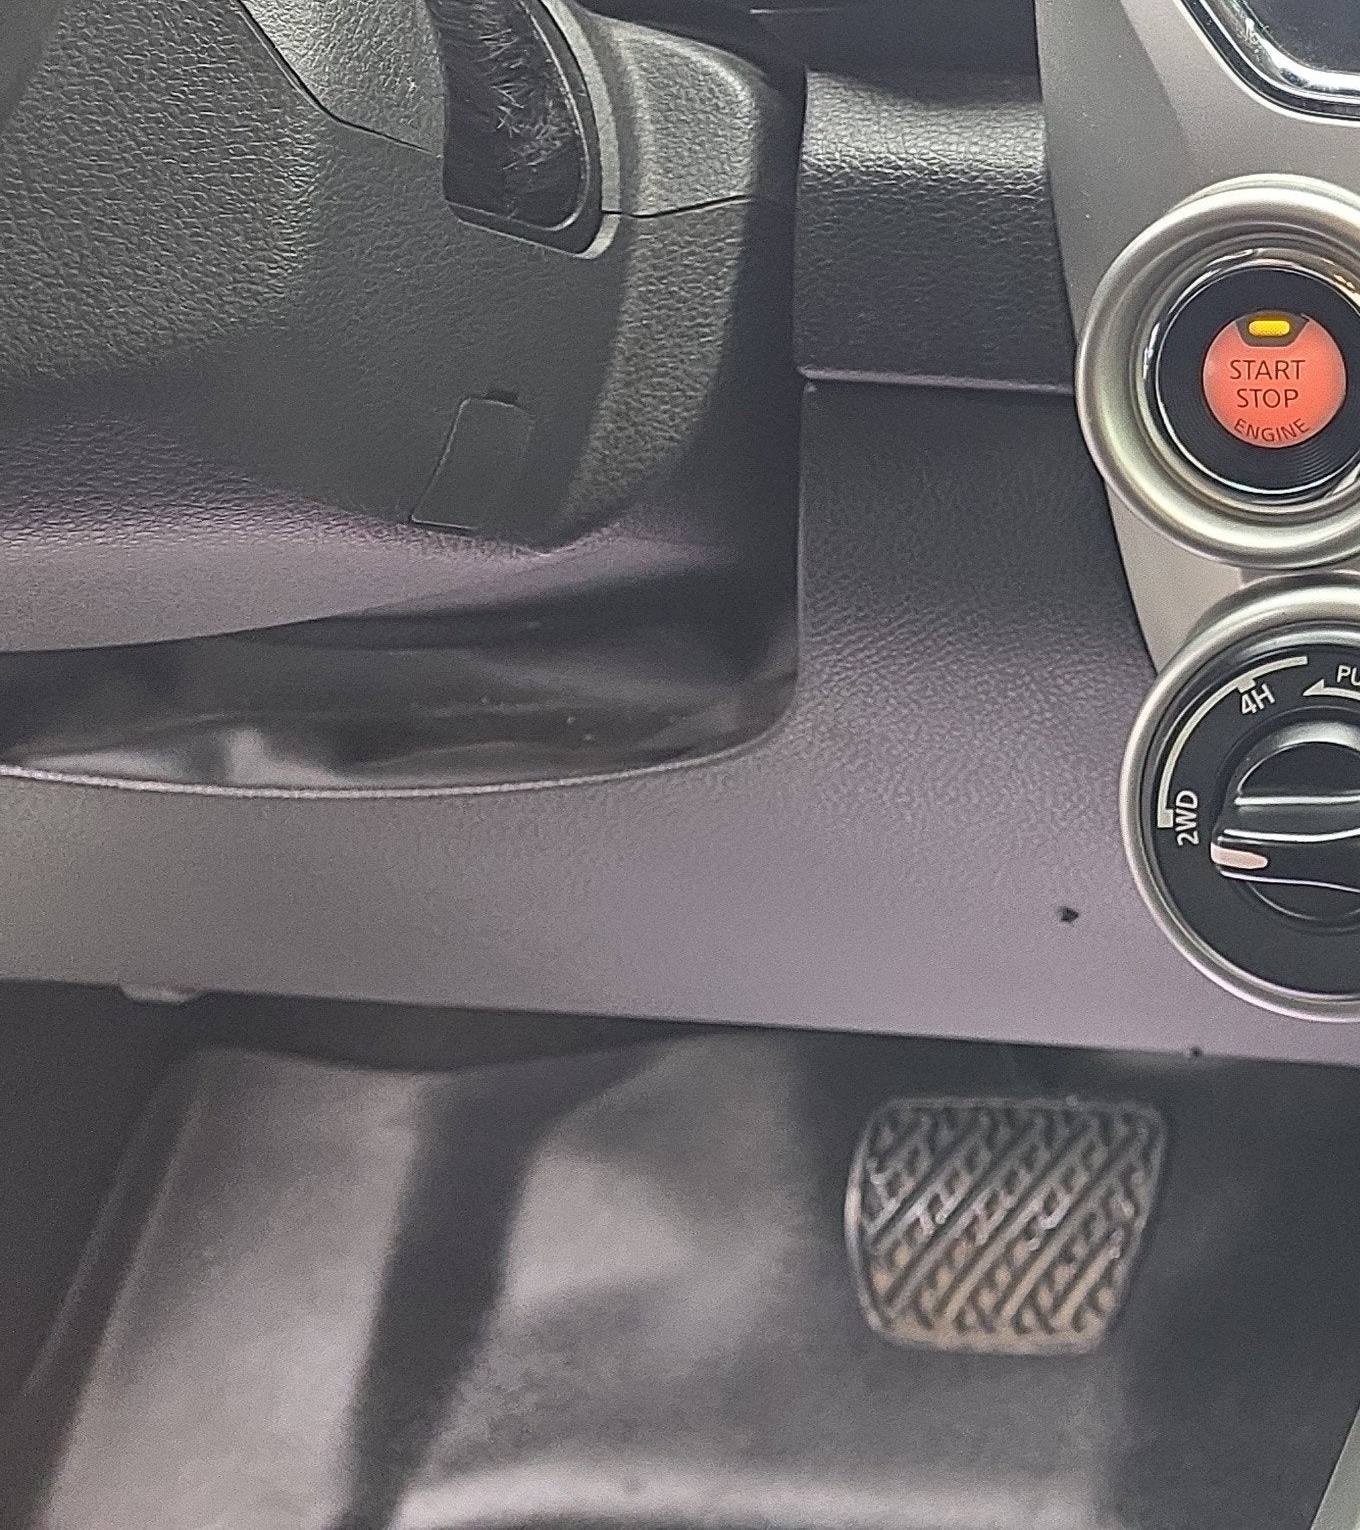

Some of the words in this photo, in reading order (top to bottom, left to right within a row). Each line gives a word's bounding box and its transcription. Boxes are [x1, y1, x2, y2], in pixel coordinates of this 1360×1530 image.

[1229, 359, 1306, 381] START
[1236, 388, 1300, 409] STOP
[1233, 418, 1310, 443] ENGINE
[1239, 683, 1275, 717] 4H
[1175, 789, 1200, 846] 2WD
